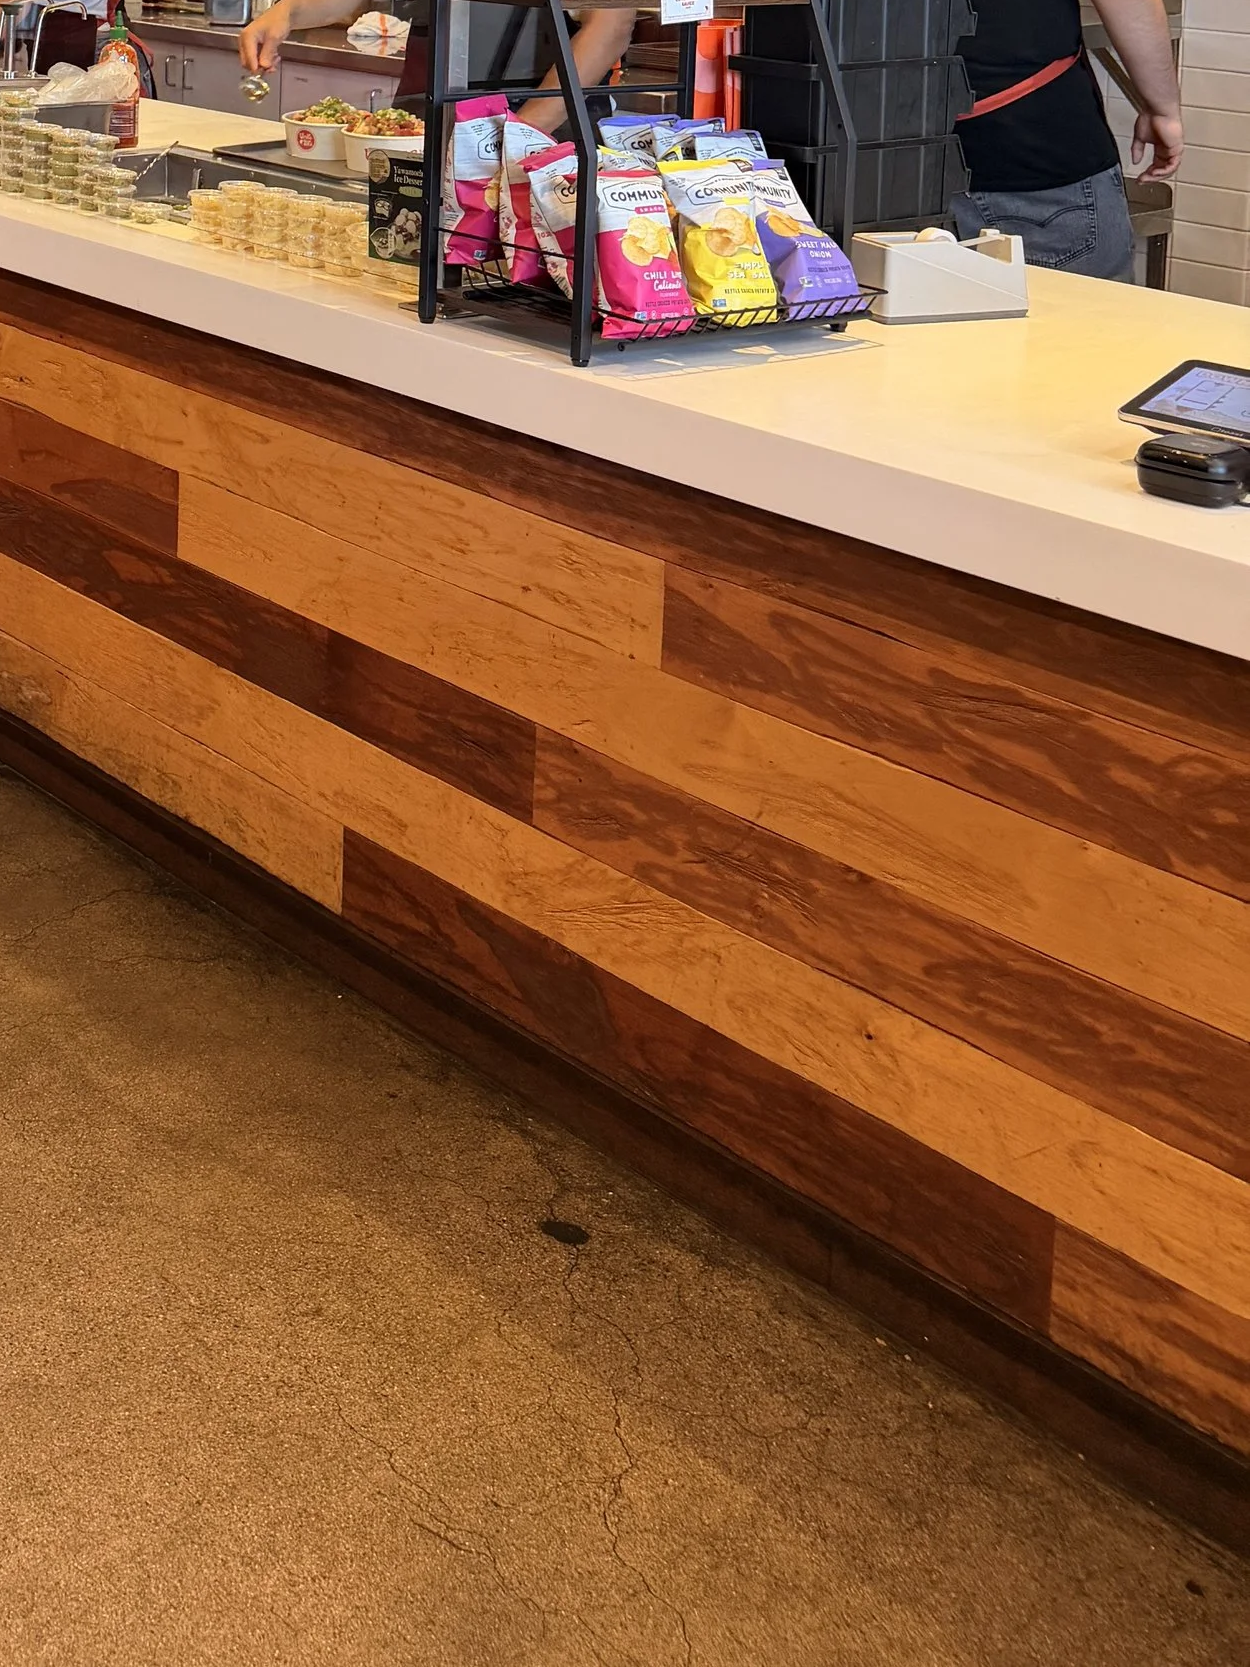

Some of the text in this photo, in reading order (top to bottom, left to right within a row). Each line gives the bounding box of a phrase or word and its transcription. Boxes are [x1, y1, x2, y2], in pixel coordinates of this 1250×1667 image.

[394, 174, 403, 184] Ice
[795, 241, 818, 249] SWEET
[644, 272, 667, 280] CHILI
